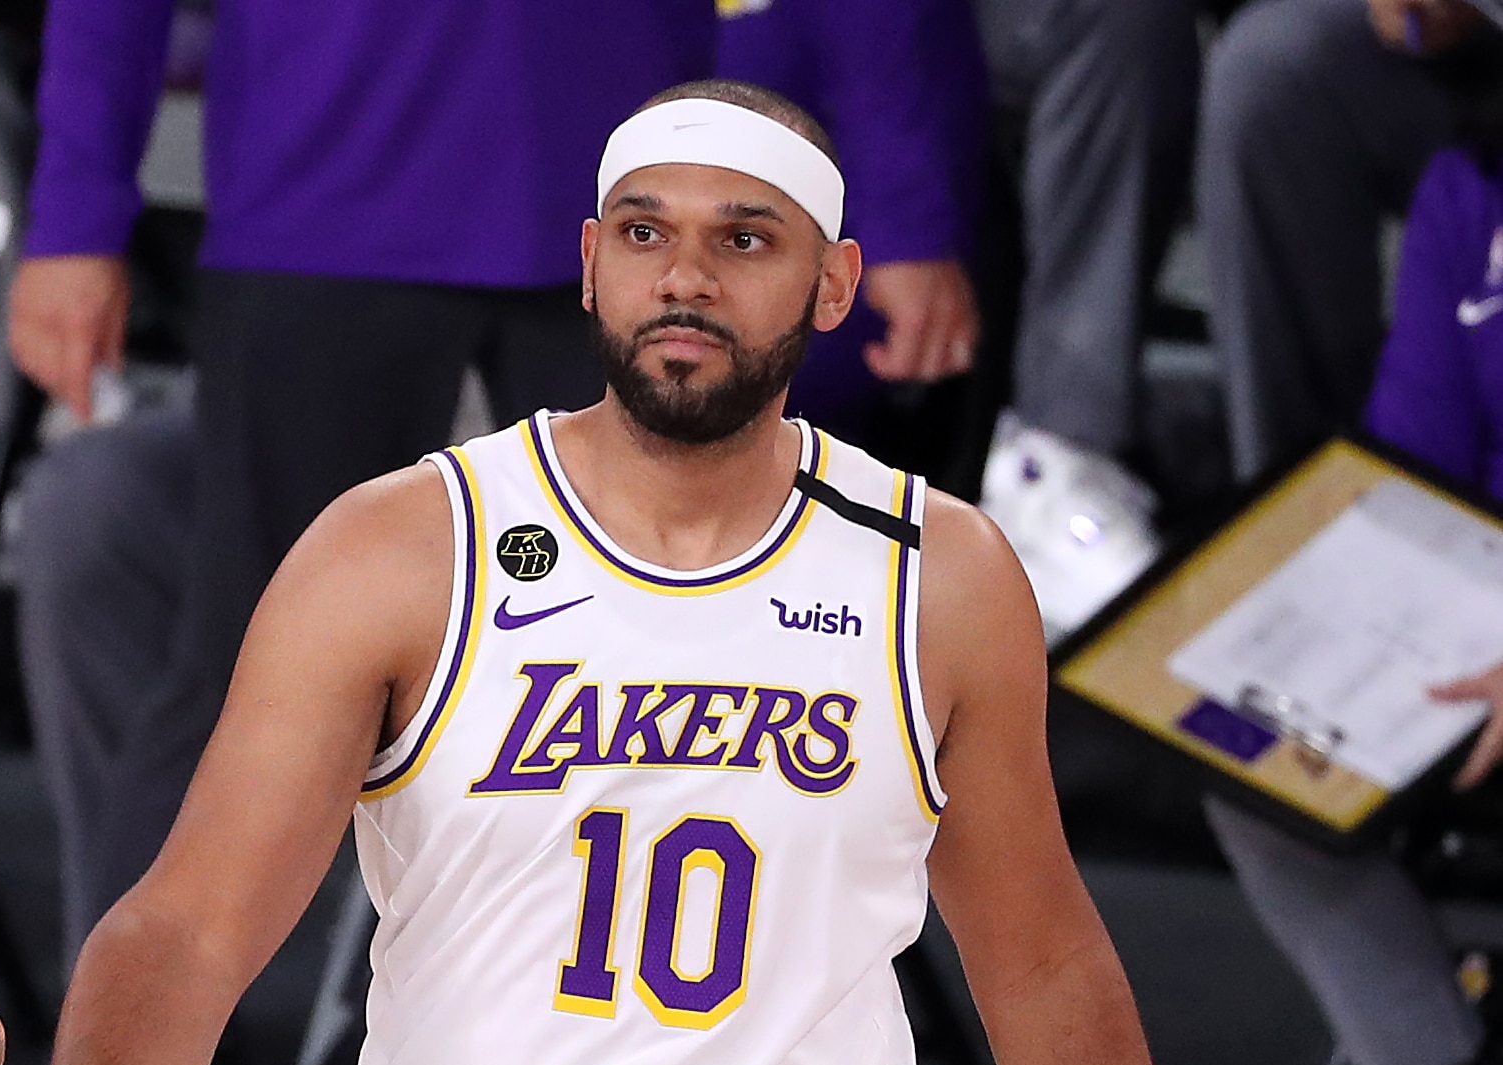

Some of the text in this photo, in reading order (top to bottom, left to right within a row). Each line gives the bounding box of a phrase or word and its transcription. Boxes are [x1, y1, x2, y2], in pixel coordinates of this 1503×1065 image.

[770, 597, 862, 637] wish
[464, 659, 861, 797] LAKERS
[552, 805, 764, 1030] 10
